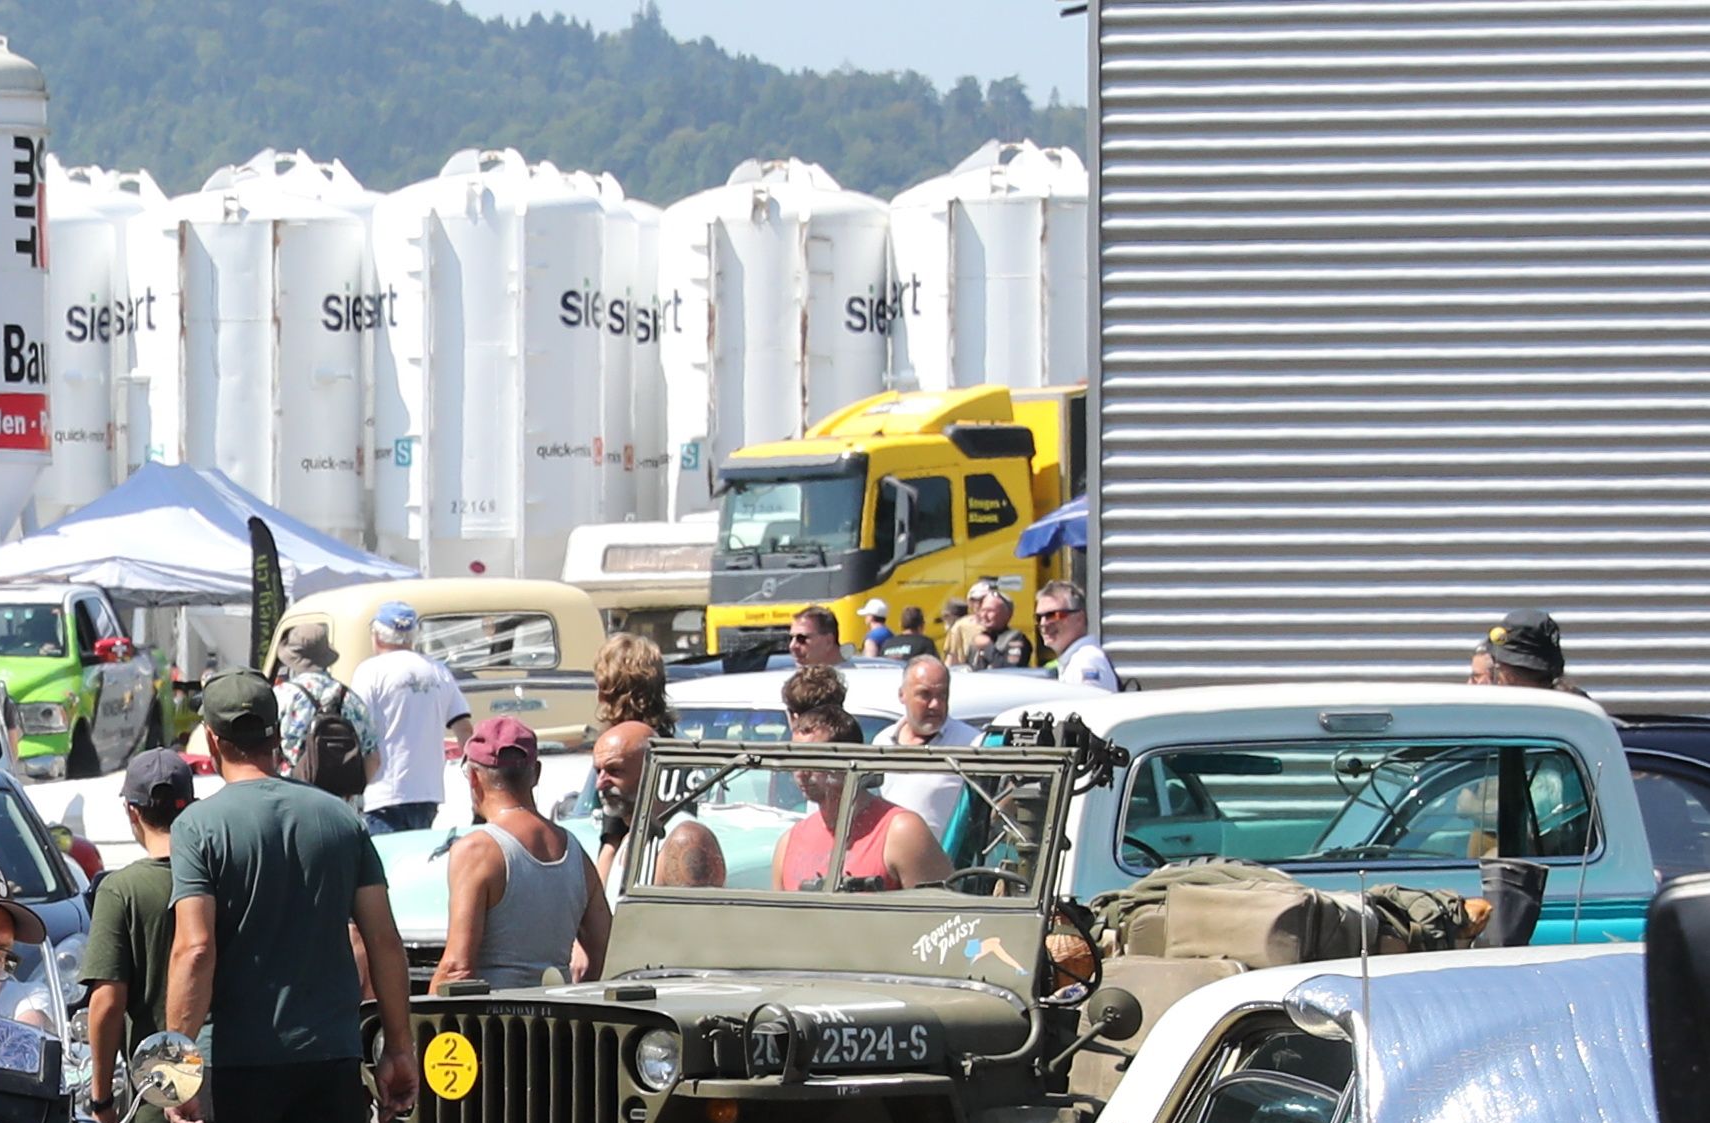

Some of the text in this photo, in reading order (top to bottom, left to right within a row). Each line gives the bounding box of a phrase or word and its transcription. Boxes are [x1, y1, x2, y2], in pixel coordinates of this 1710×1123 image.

[912, 914, 961, 962] TEQUILA
[937, 918, 982, 965] DAISY
[443, 1037, 459, 1061] 2
[443, 1070, 459, 1094] 2
